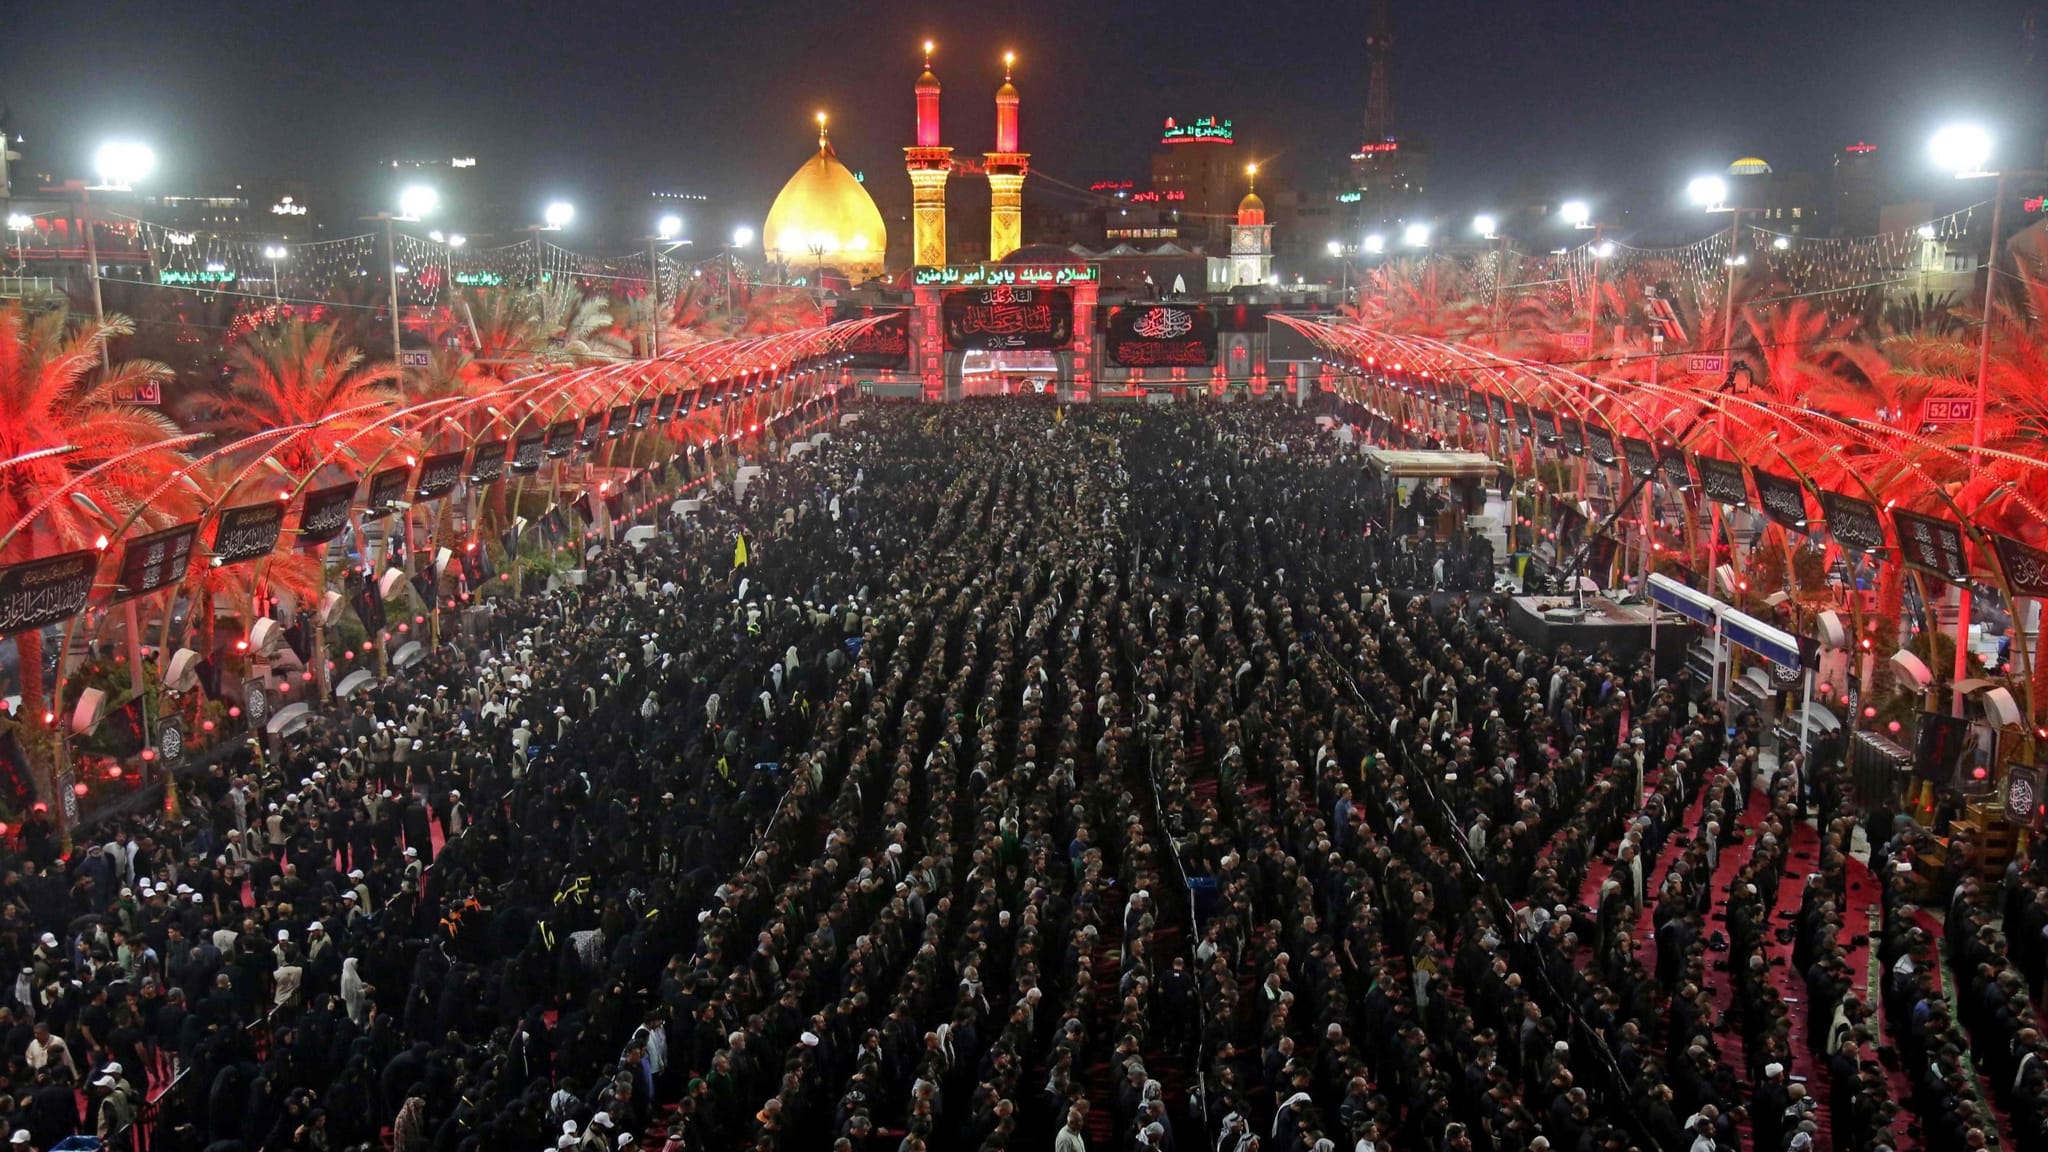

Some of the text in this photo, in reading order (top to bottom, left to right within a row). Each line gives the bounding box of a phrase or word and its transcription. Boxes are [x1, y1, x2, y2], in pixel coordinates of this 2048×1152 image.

[960, 265, 984, 285] أمير
[1019, 268, 1052, 284] عليك
[1055, 268, 1096, 285] السلام
[404, 354, 415, 364] 64
[1930, 403, 1948, 418] 52
